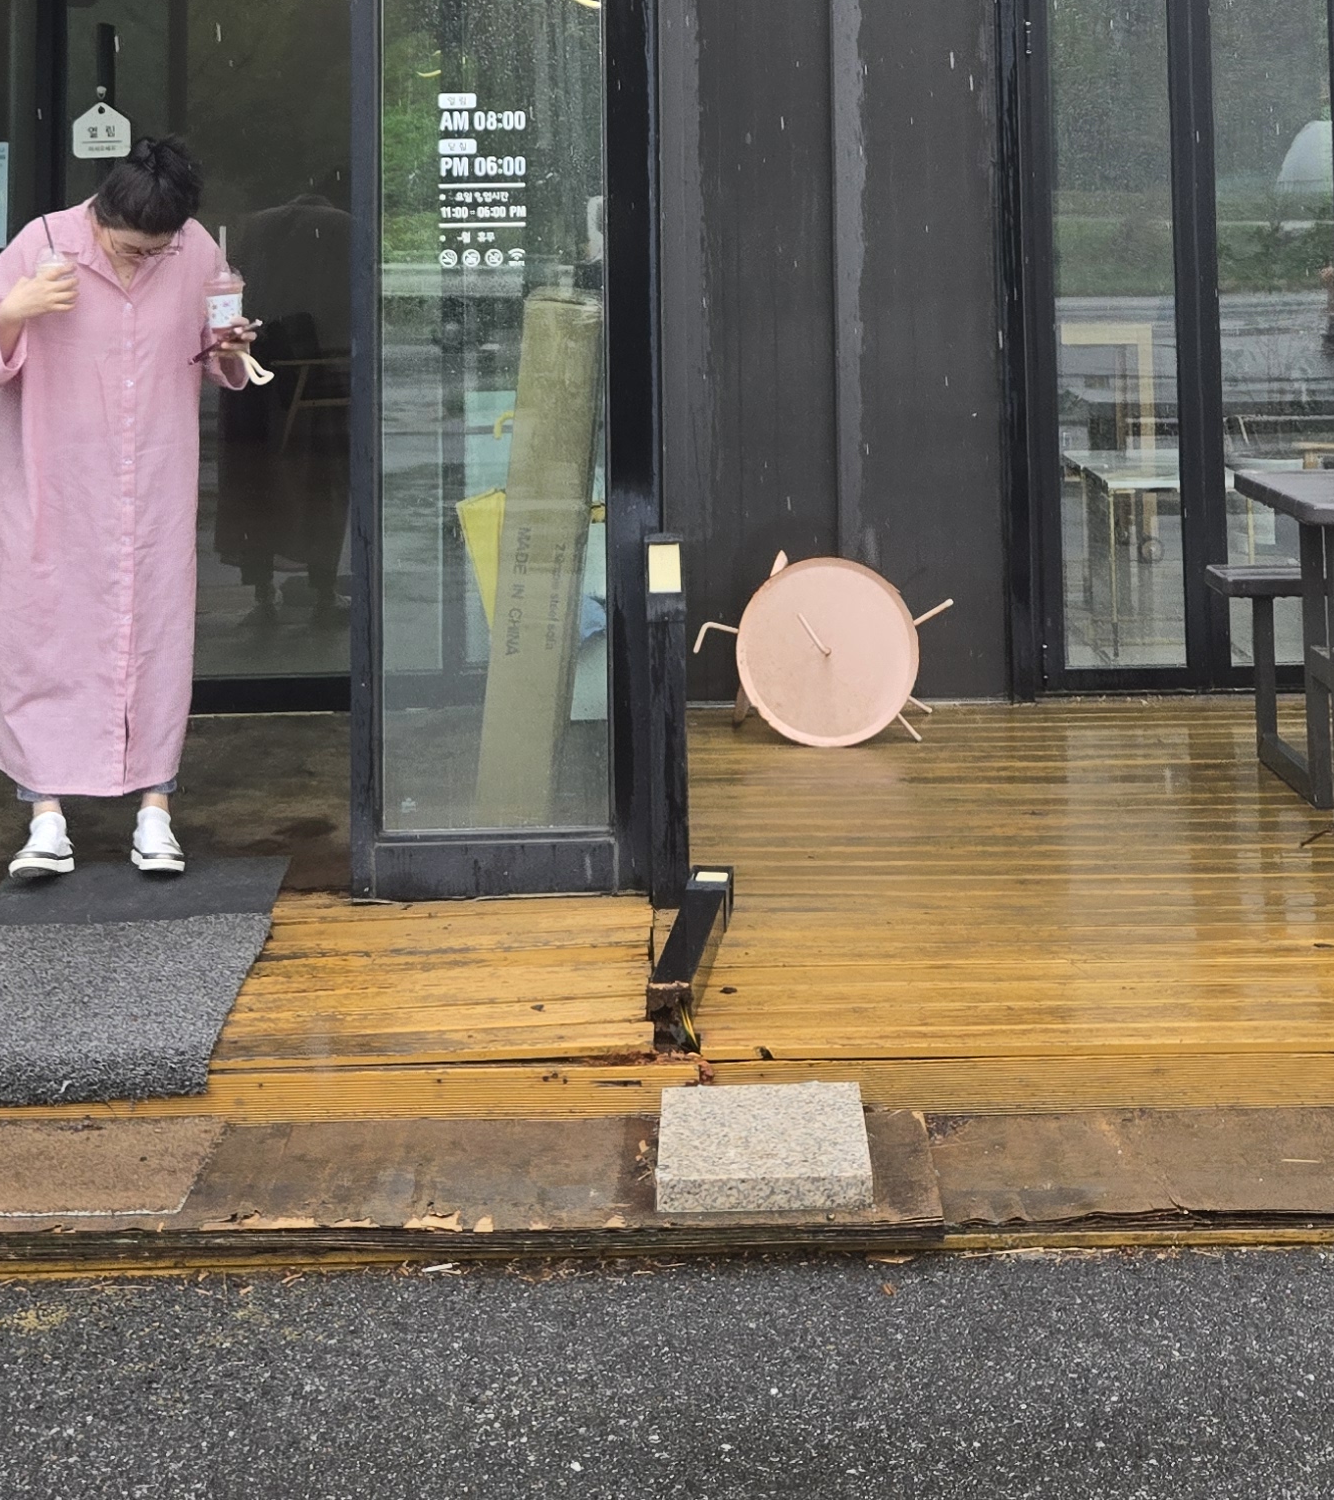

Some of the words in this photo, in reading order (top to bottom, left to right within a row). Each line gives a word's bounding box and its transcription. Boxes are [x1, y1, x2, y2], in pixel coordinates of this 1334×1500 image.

[440, 111, 469, 131] AM
[474, 110, 526, 131] 08:00
[440, 156, 469, 177] PM
[474, 156, 526, 177] 06:00
[440, 206, 469, 218] 11:00
[509, 205, 527, 218] PM
[513, 527, 532, 575] MADE
[511, 583, 526, 599] IN
[505, 607, 523, 655] CHINA
